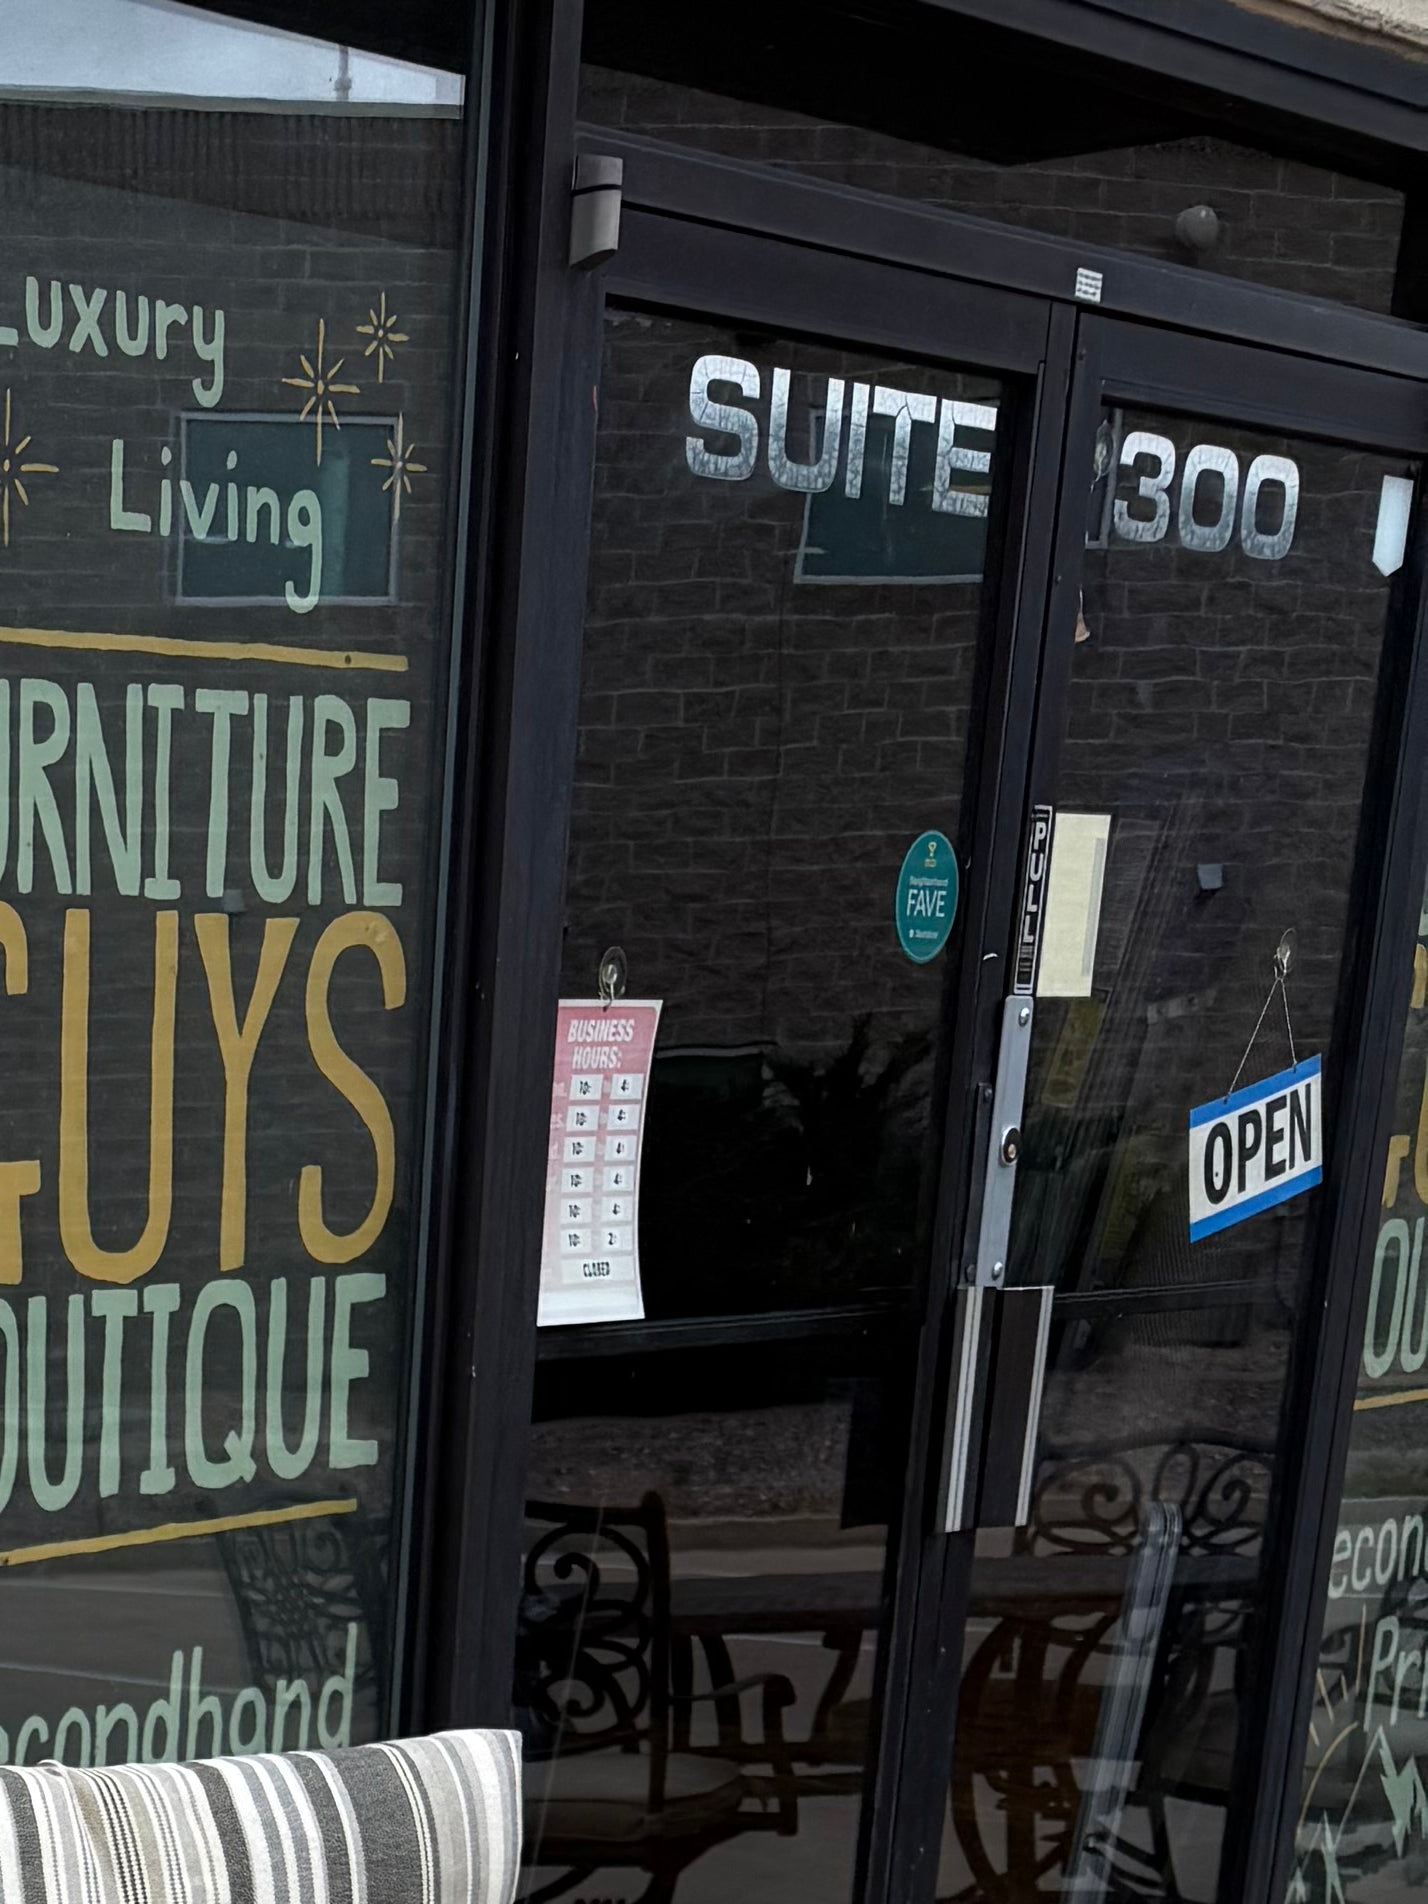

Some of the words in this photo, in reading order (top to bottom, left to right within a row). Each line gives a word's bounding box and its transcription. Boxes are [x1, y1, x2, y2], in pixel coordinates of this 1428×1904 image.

[685, 355, 997, 518] SUITE
[1114, 431, 1300, 560] 300
[110, 438, 323, 613] Living
[906, 888, 947, 917] FAVE
[1023, 821, 1047, 943] PULL
[568, 1019, 635, 1043] BUSINESS
[1204, 1082, 1311, 1204] OPEN
